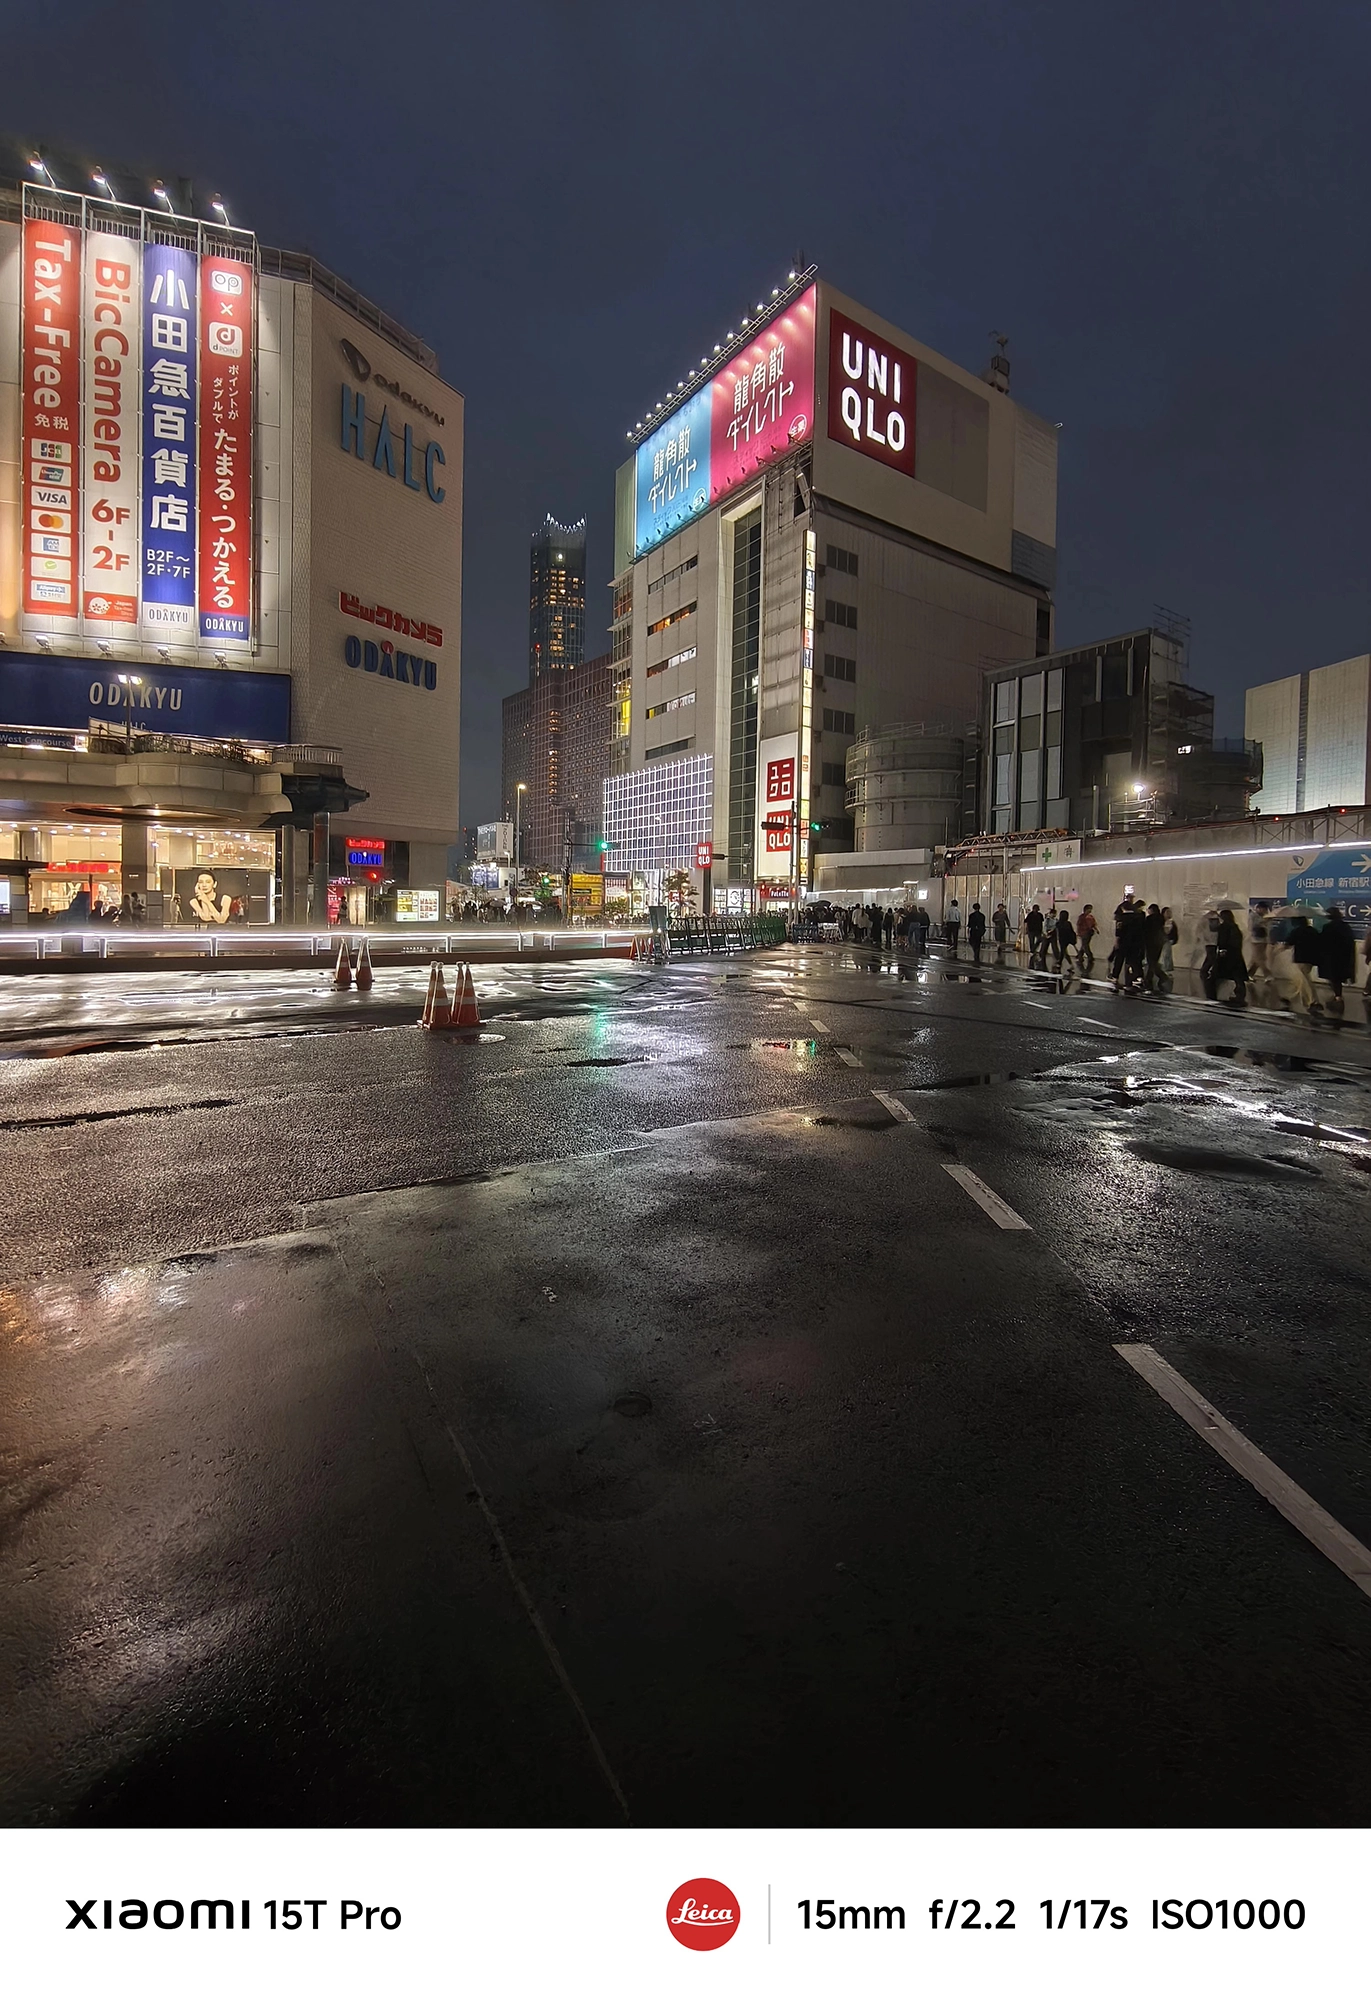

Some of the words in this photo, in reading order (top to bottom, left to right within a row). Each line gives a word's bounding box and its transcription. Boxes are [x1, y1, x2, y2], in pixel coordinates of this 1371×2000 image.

[214, 273, 240, 292] op
[33, 239, 71, 408] Tax-Free
[93, 258, 131, 482] BicCamera
[212, 343, 219, 351] d
[219, 346, 239, 355] POINT
[842, 332, 901, 404] UNI
[149, 269, 190, 532] 小田急百貨店
[212, 377, 224, 424] ダブルで
[228, 364, 239, 420] ポイントが
[373, 373, 446, 427] odakyu
[733, 342, 786, 415] 龍角散
[35, 413, 69, 431] 免税
[726, 381, 795, 451] ダイレクト
[841, 387, 906, 452] QLO
[340, 382, 446, 504] HALC
[653, 424, 691, 482] 龍角散
[36, 490, 68, 505] VISA
[647, 458, 697, 514] ダイレクト
[92, 499, 131, 525] 6F
[211, 428, 238, 609] たまる・つかえる
[92, 545, 130, 572] 2F
[149, 608, 189, 624] ODAKYU
[205, 616, 244, 633] ODAKYU
[338, 590, 444, 648] ビックカメラ
[344, 634, 438, 691] ODAKYU
[89, 681, 183, 711] ODAKYU
[0, 734, 22, 743] West
[24, 736, 72, 747] Concourse
[350, 851, 383, 865] ODAKYU
[698, 846, 710, 855] UNI
[698, 855, 711, 866] QLO
[769, 831, 791, 850] QLO
[1296, 877, 1335, 888] 小田急線
[1338, 876, 1371, 888] 新宿駅
